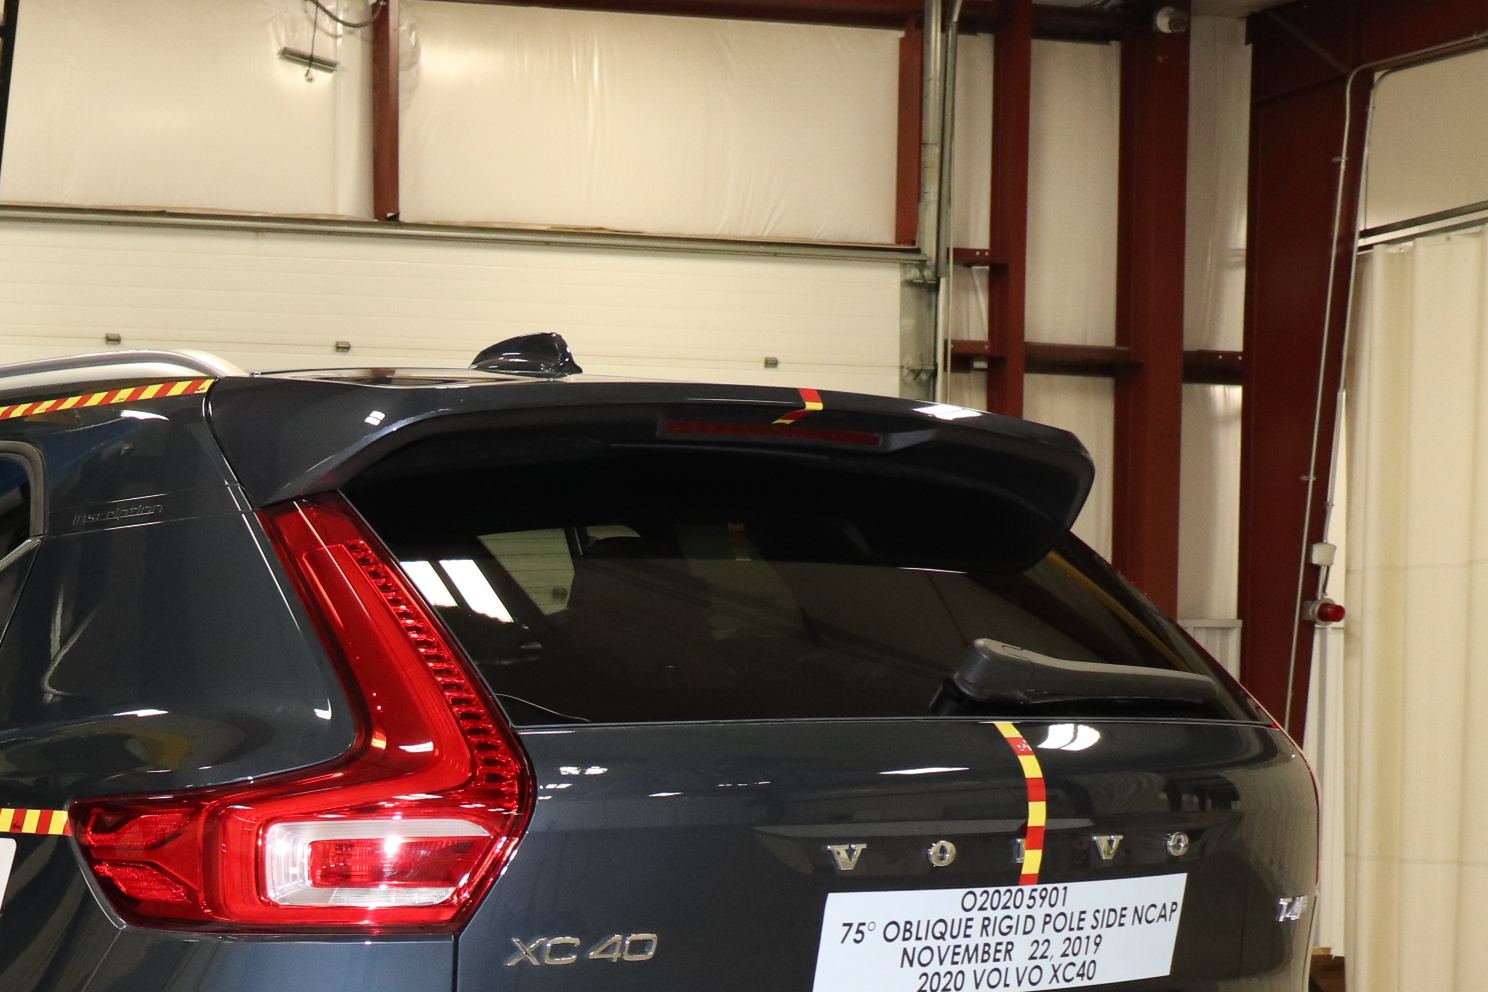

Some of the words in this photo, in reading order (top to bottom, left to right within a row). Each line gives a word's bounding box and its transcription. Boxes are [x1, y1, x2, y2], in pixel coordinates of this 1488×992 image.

[841, 921, 876, 944] 75°
[883, 917, 974, 943] OBLIQUE
[980, 914, 1035, 937] RIGID
[1042, 910, 1087, 934] POLE
[1091, 906, 1128, 929] SIDE
[1132, 901, 1178, 926] NCAP
[900, 941, 1014, 968] NOVEMBER
[1028, 938, 1054, 962] 22,
[1060, 934, 1103, 958] 2019
[973, 965, 1043, 990] VOLVO
[1048, 959, 1097, 985] XC40
